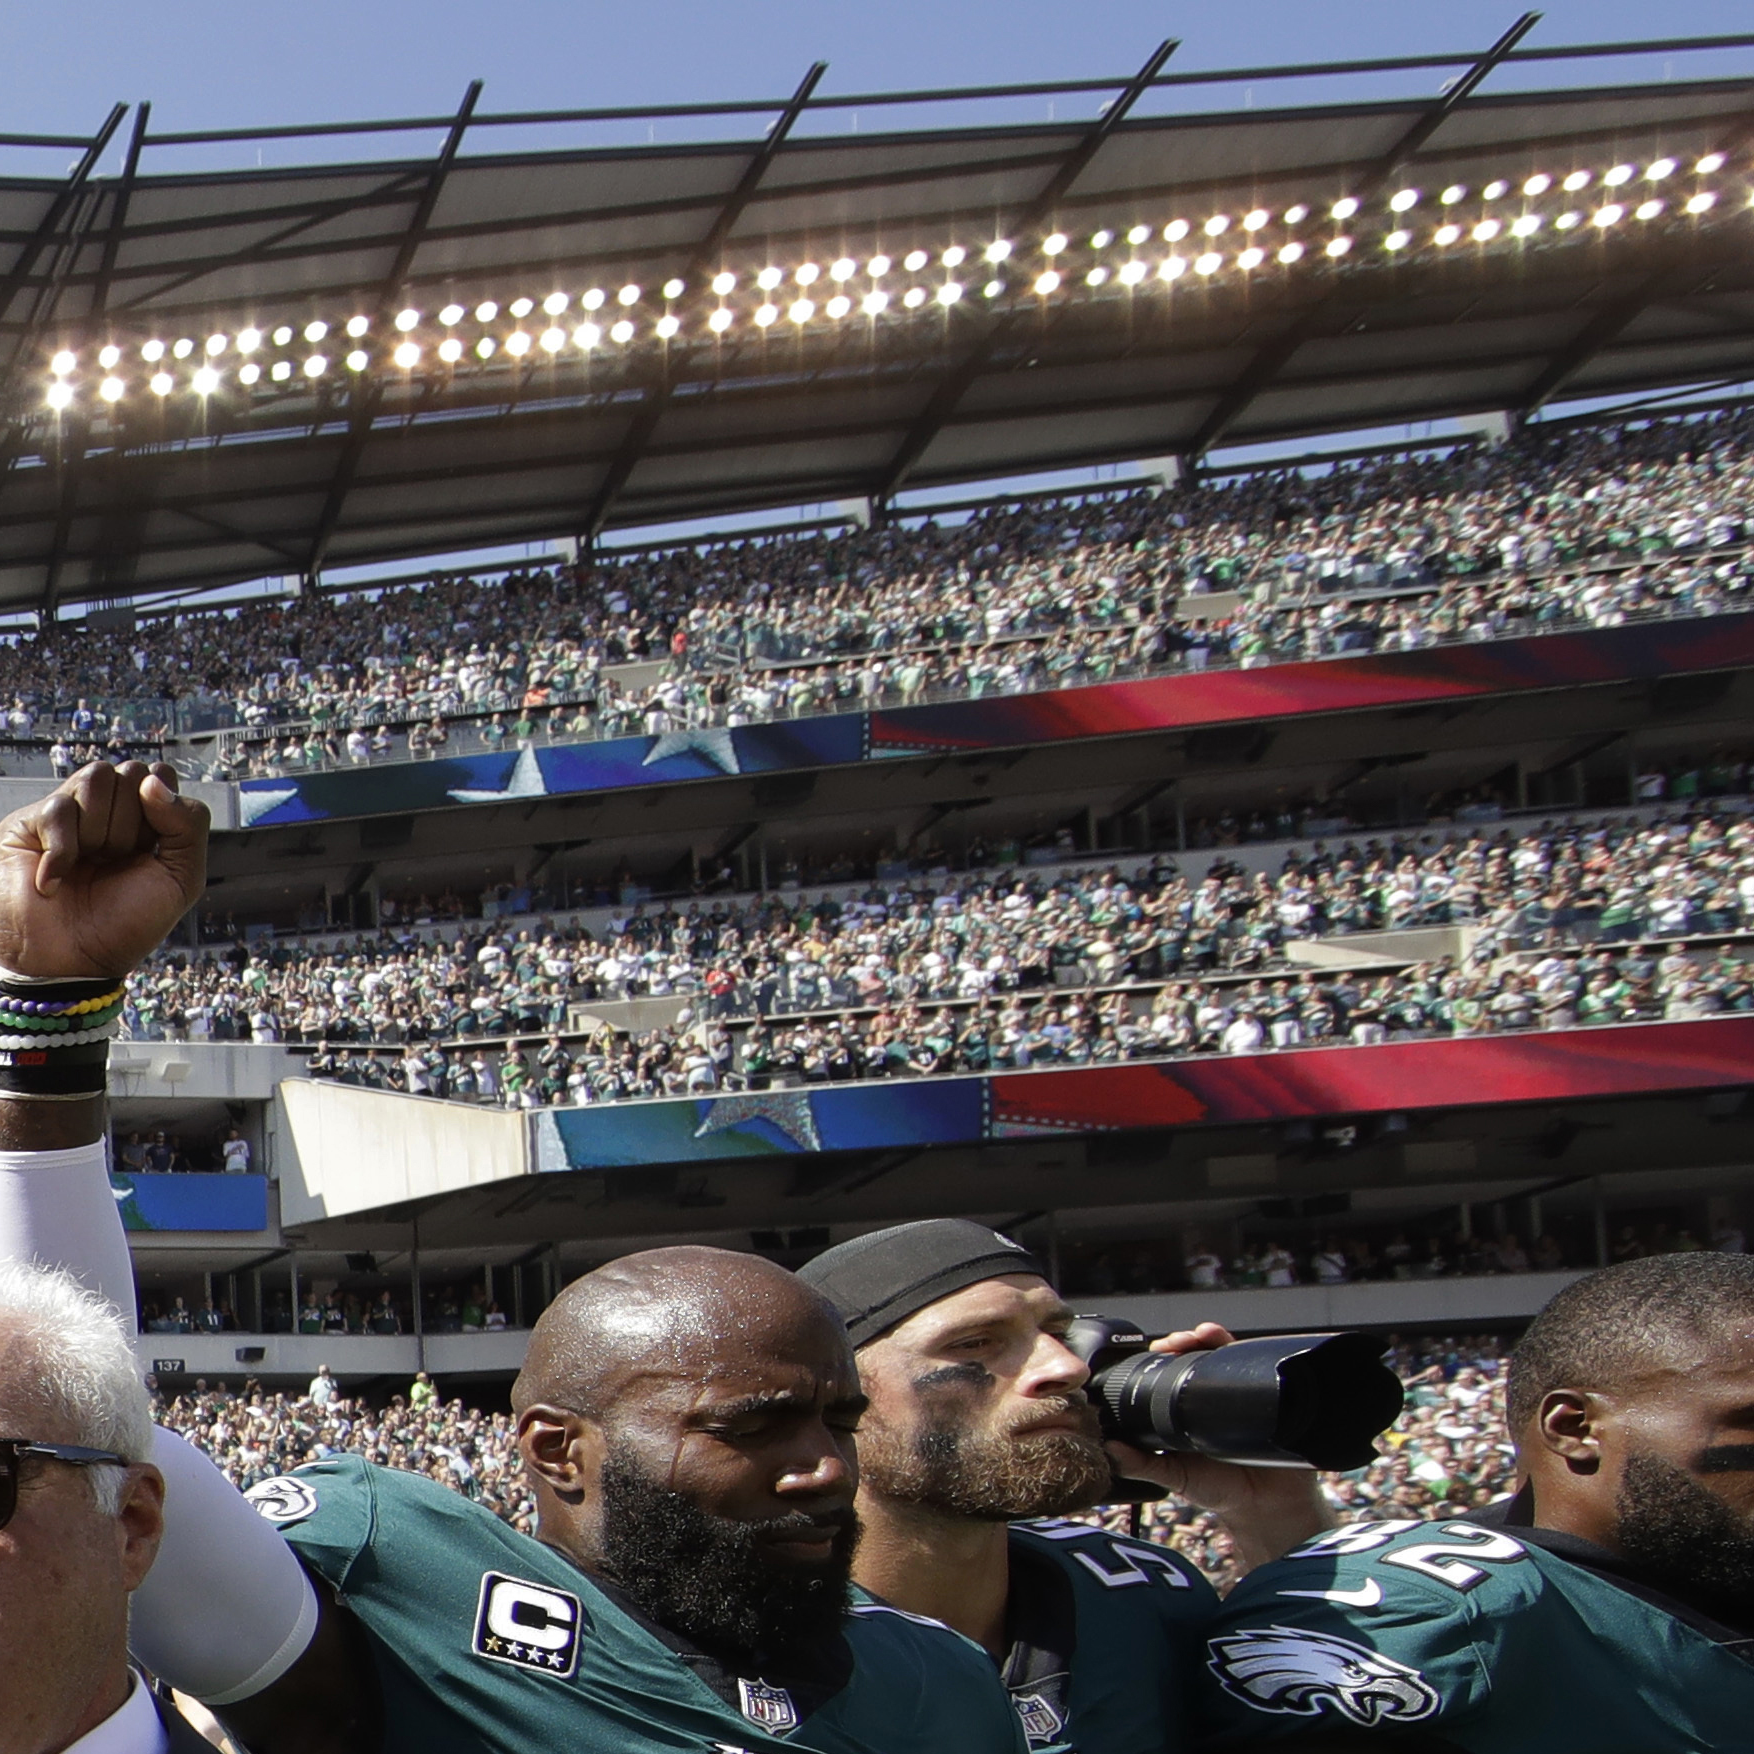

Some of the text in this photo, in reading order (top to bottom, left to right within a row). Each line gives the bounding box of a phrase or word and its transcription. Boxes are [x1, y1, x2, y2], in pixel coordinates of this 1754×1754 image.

[1111, 1333, 1144, 1344] Canon
[156, 1359, 181, 1372] 137
[487, 1579, 579, 1651] C
[750, 1697, 789, 1723] NFL
